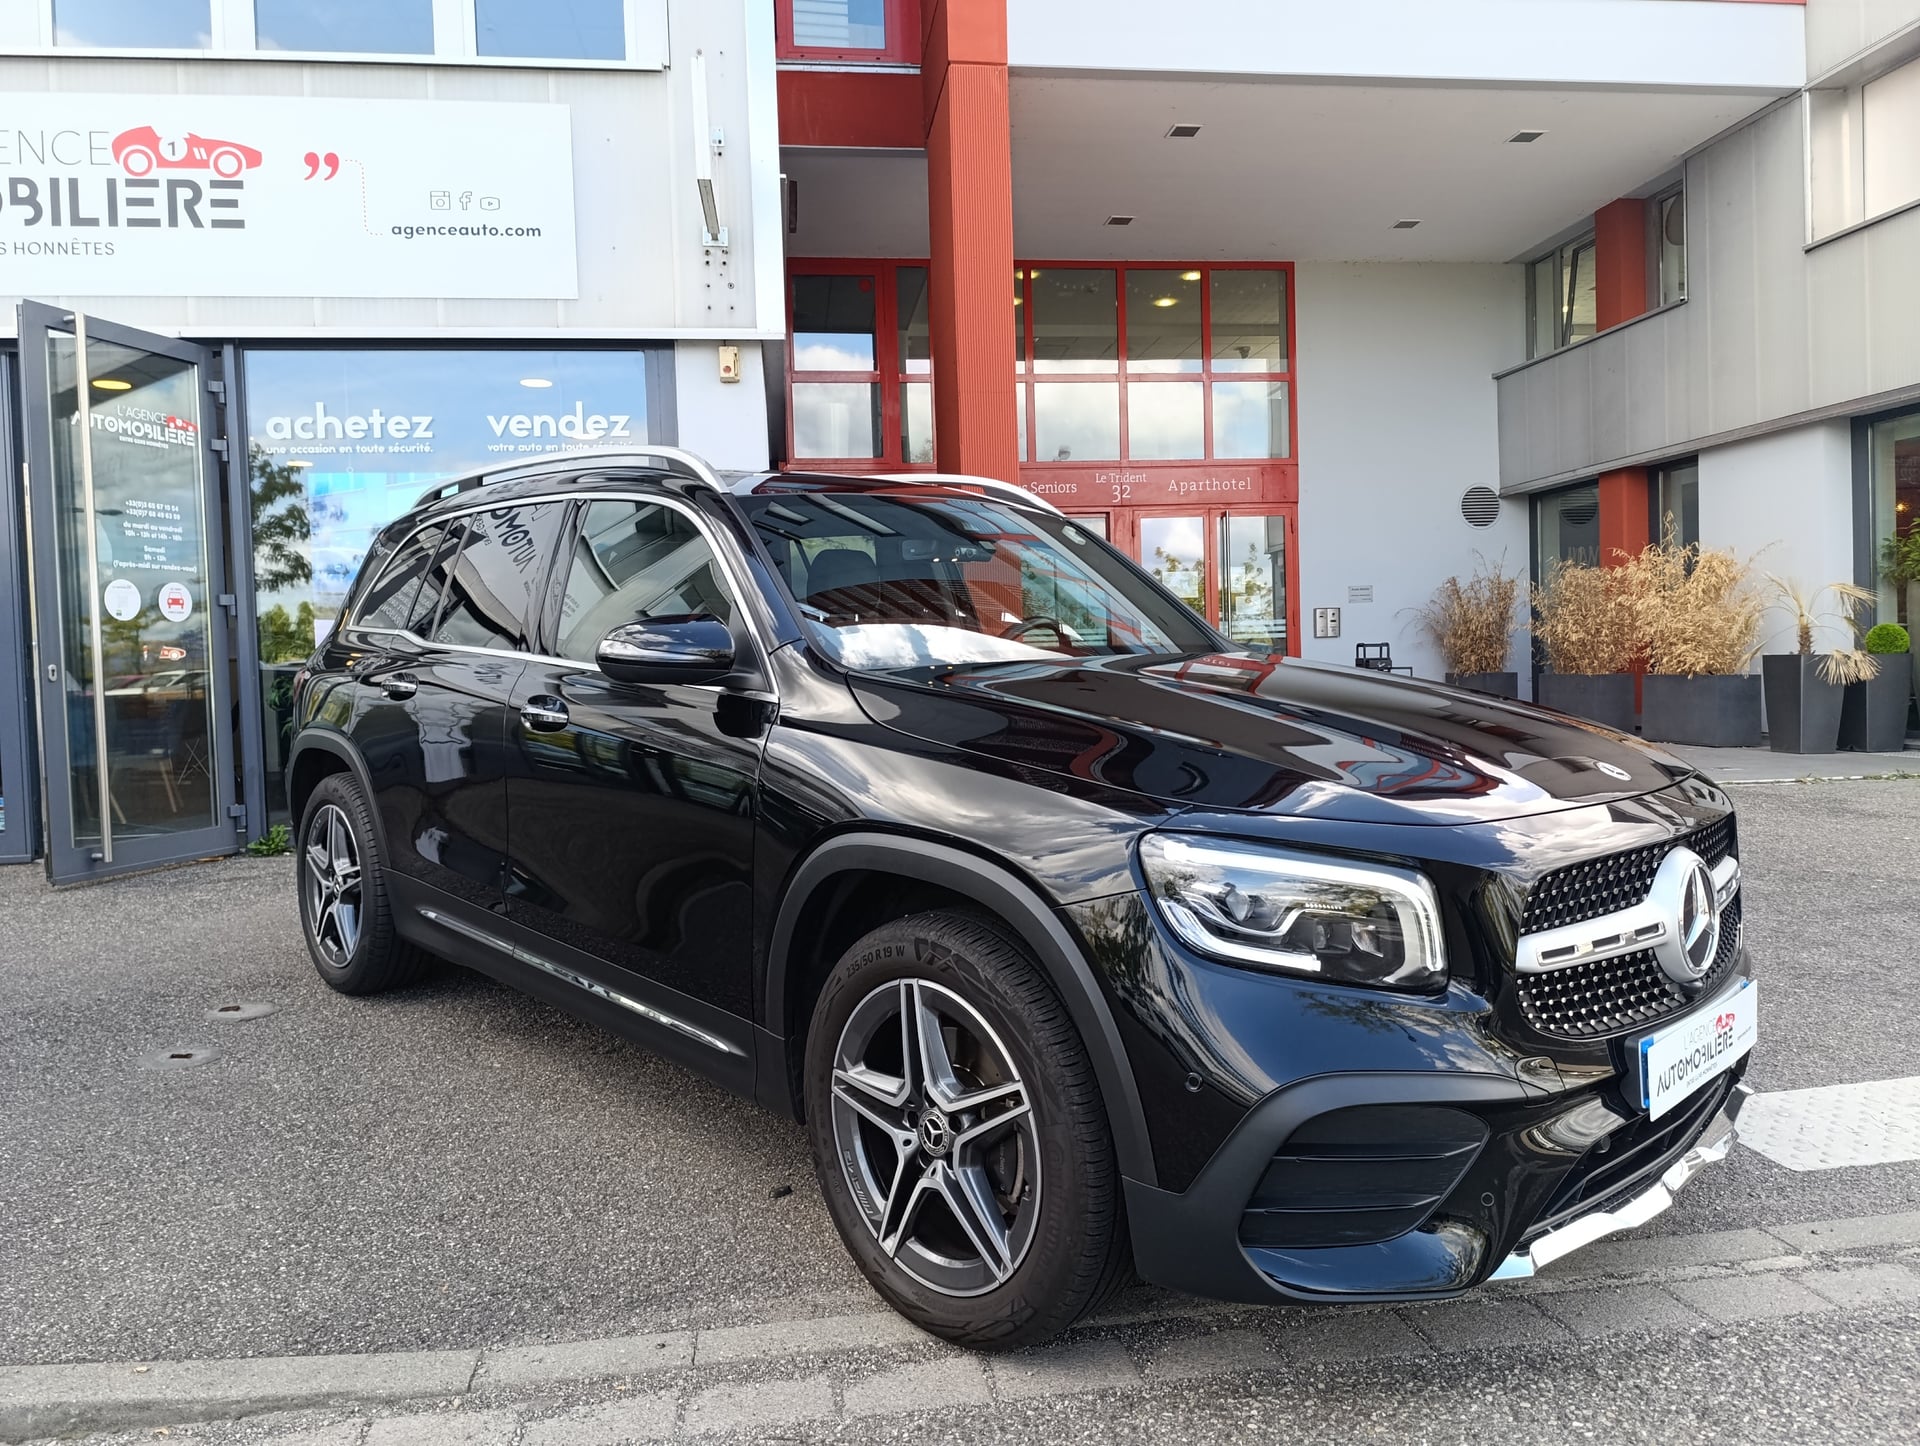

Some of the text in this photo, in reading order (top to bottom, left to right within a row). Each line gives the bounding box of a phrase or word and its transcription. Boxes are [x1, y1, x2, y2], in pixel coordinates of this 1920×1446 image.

[0, 177, 246, 229] BILIERE
[391, 222, 542, 240] agenceauto.com
[13, 237, 115, 256] HONNÊTES
[117, 404, 167, 425] L'AGENCE
[265, 401, 433, 440] achetez
[486, 401, 631, 438] vendez
[266, 442, 433, 454] une occasion en toute sécurité.
[487, 443, 515, 452] votre
[518, 443, 542, 452] auto
[545, 444, 558, 452] en
[1095, 472, 1147, 483] Le Trident
[1168, 477, 1252, 495] Aparthotel
[1030, 481, 1078, 494] Seniors
[1112, 485, 1131, 503] 32
[846, 945, 905, 978] 235/50 R 19 W
[1656, 1026, 1734, 1097] AUTOMOBILIERE
